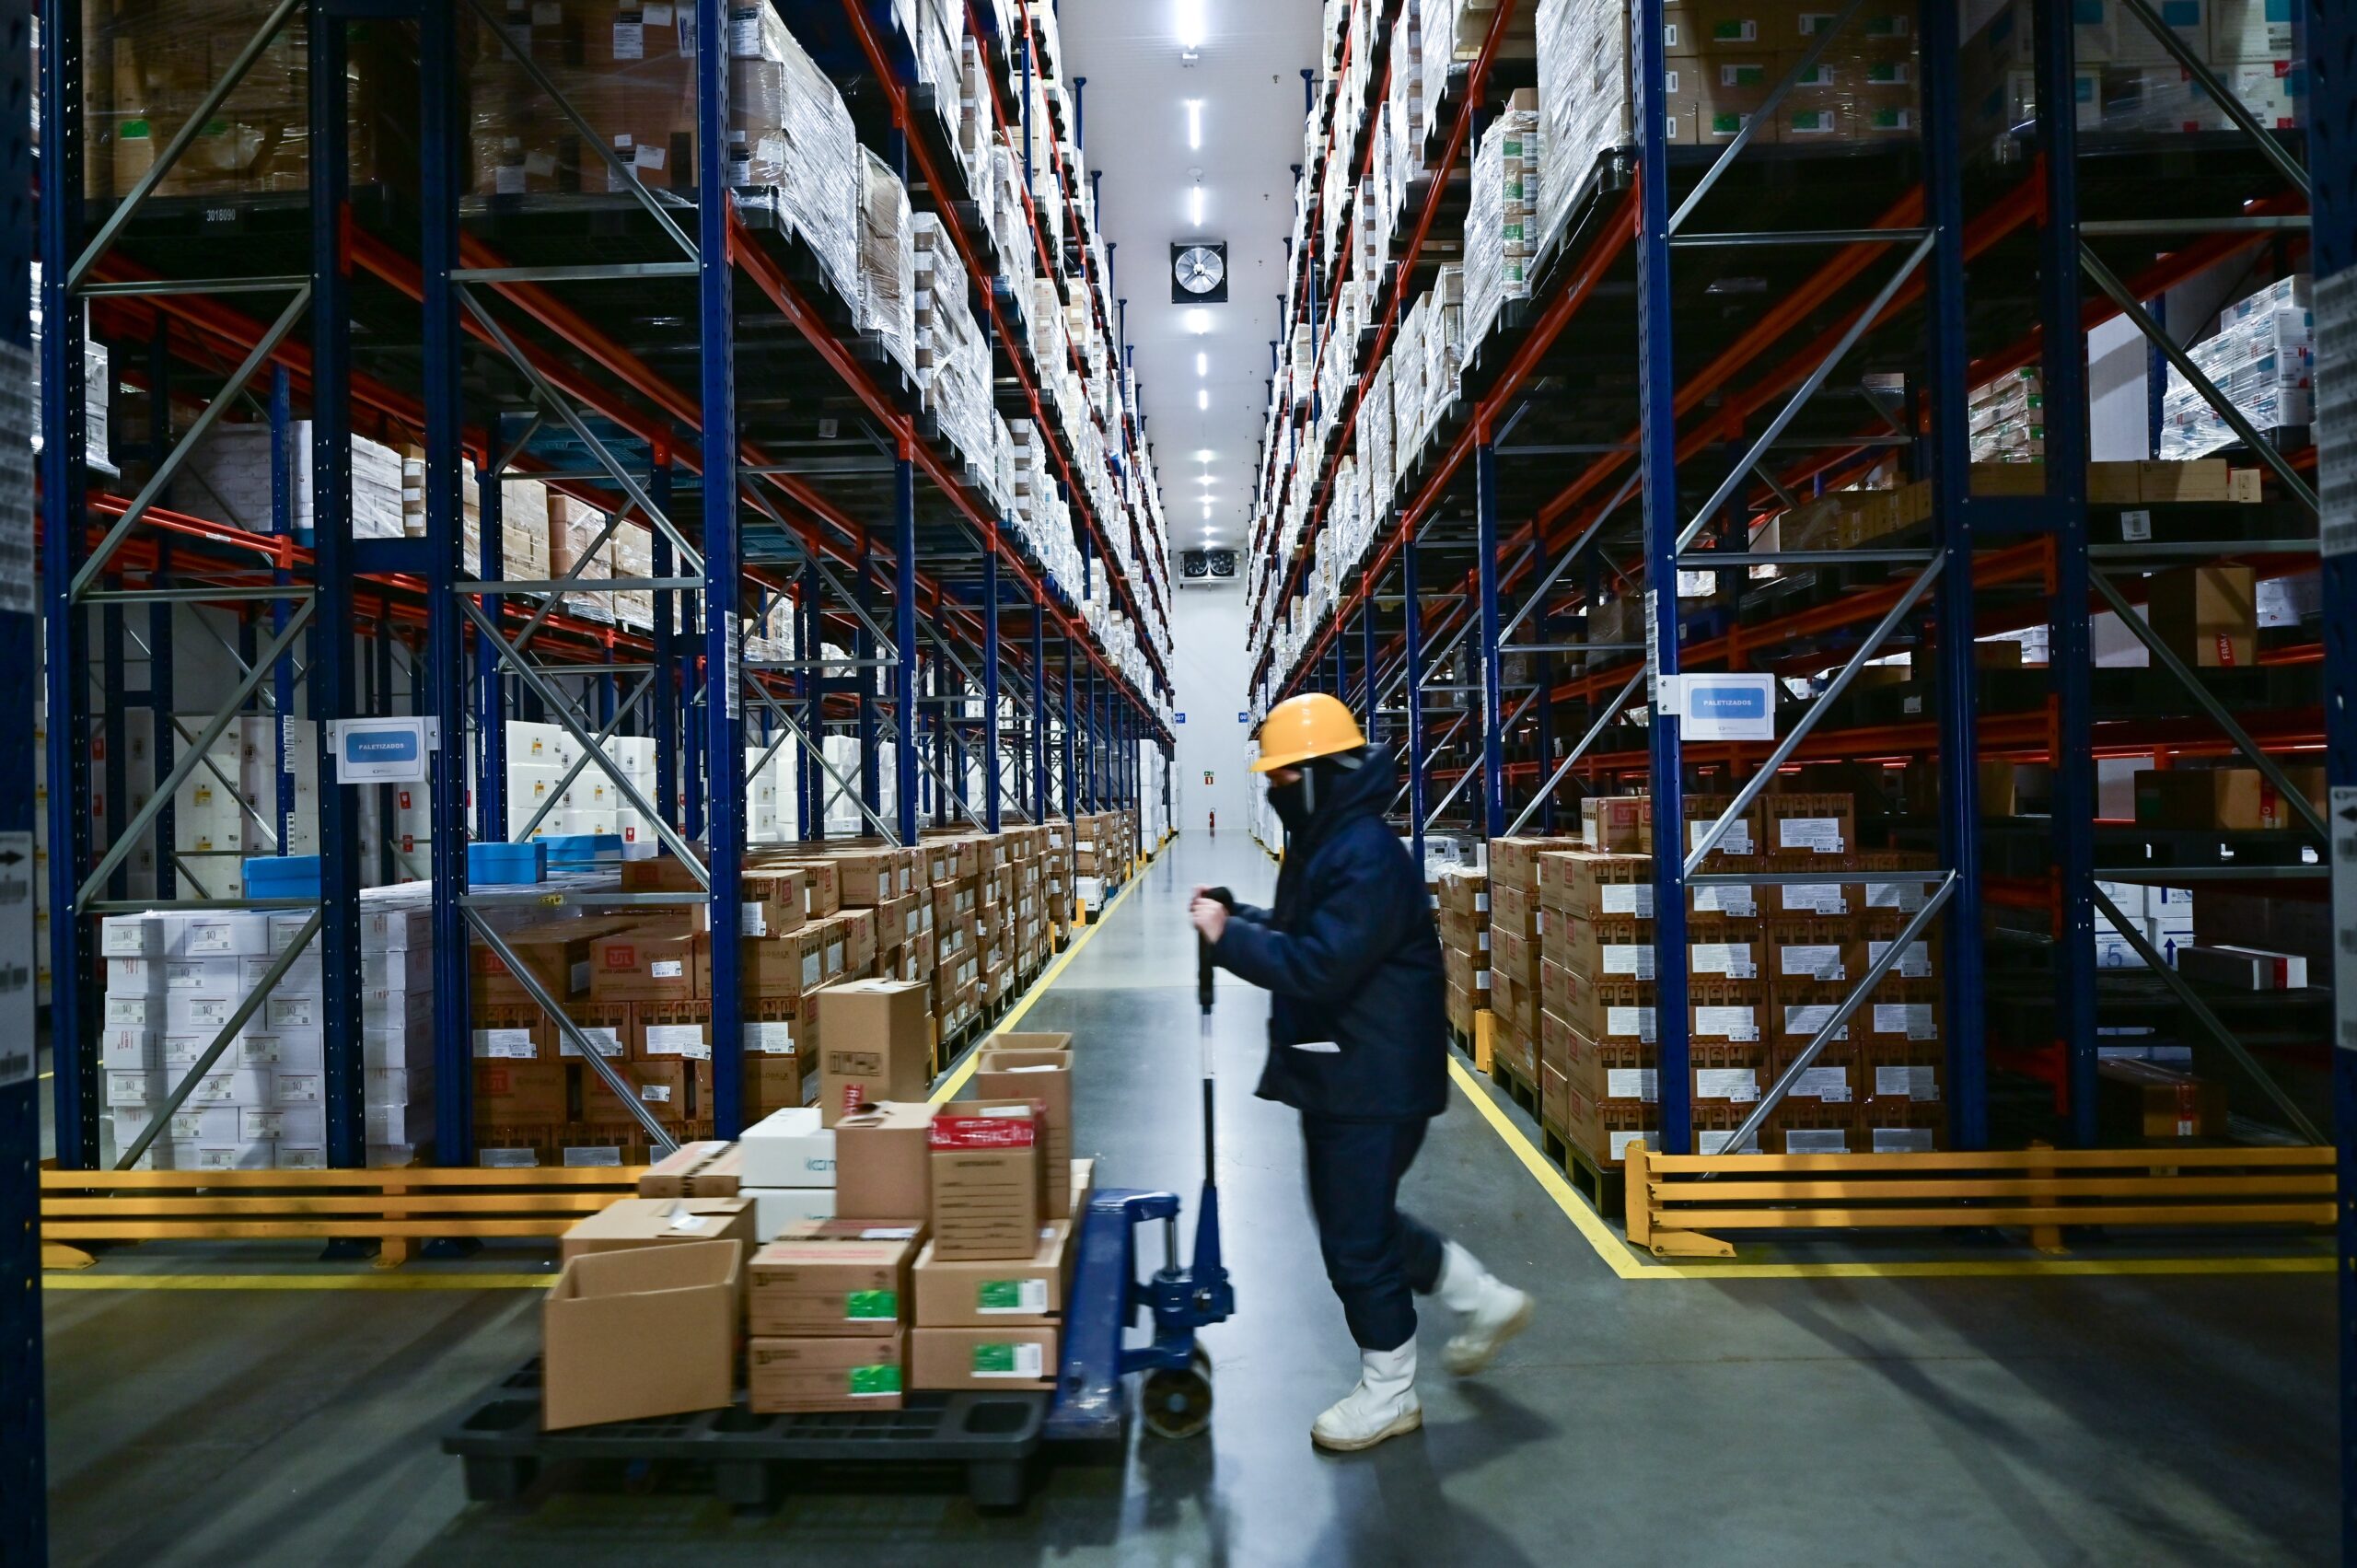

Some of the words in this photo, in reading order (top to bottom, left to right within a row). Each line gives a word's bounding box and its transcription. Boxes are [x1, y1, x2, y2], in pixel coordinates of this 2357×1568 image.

[206, 209, 236, 222] 3018090
[359, 742, 404, 750] PALETIZADOS
[122, 930, 133, 940] 10
[206, 930, 216, 940] 10
[2107, 943, 2122, 967] 5
[180, 968, 190, 977] 10
[122, 1005, 132, 1014] 10
[203, 1005, 213, 1015] 10
[286, 1005, 296, 1015] 10
[175, 1043, 184, 1052] 10
[256, 1043, 265, 1052] 10
[125, 1081, 134, 1090] 10
[209, 1081, 219, 1090] 10
[293, 1082, 302, 1091] 10
[179, 1119, 188, 1128] 10
[259, 1119, 268, 1128] 10
